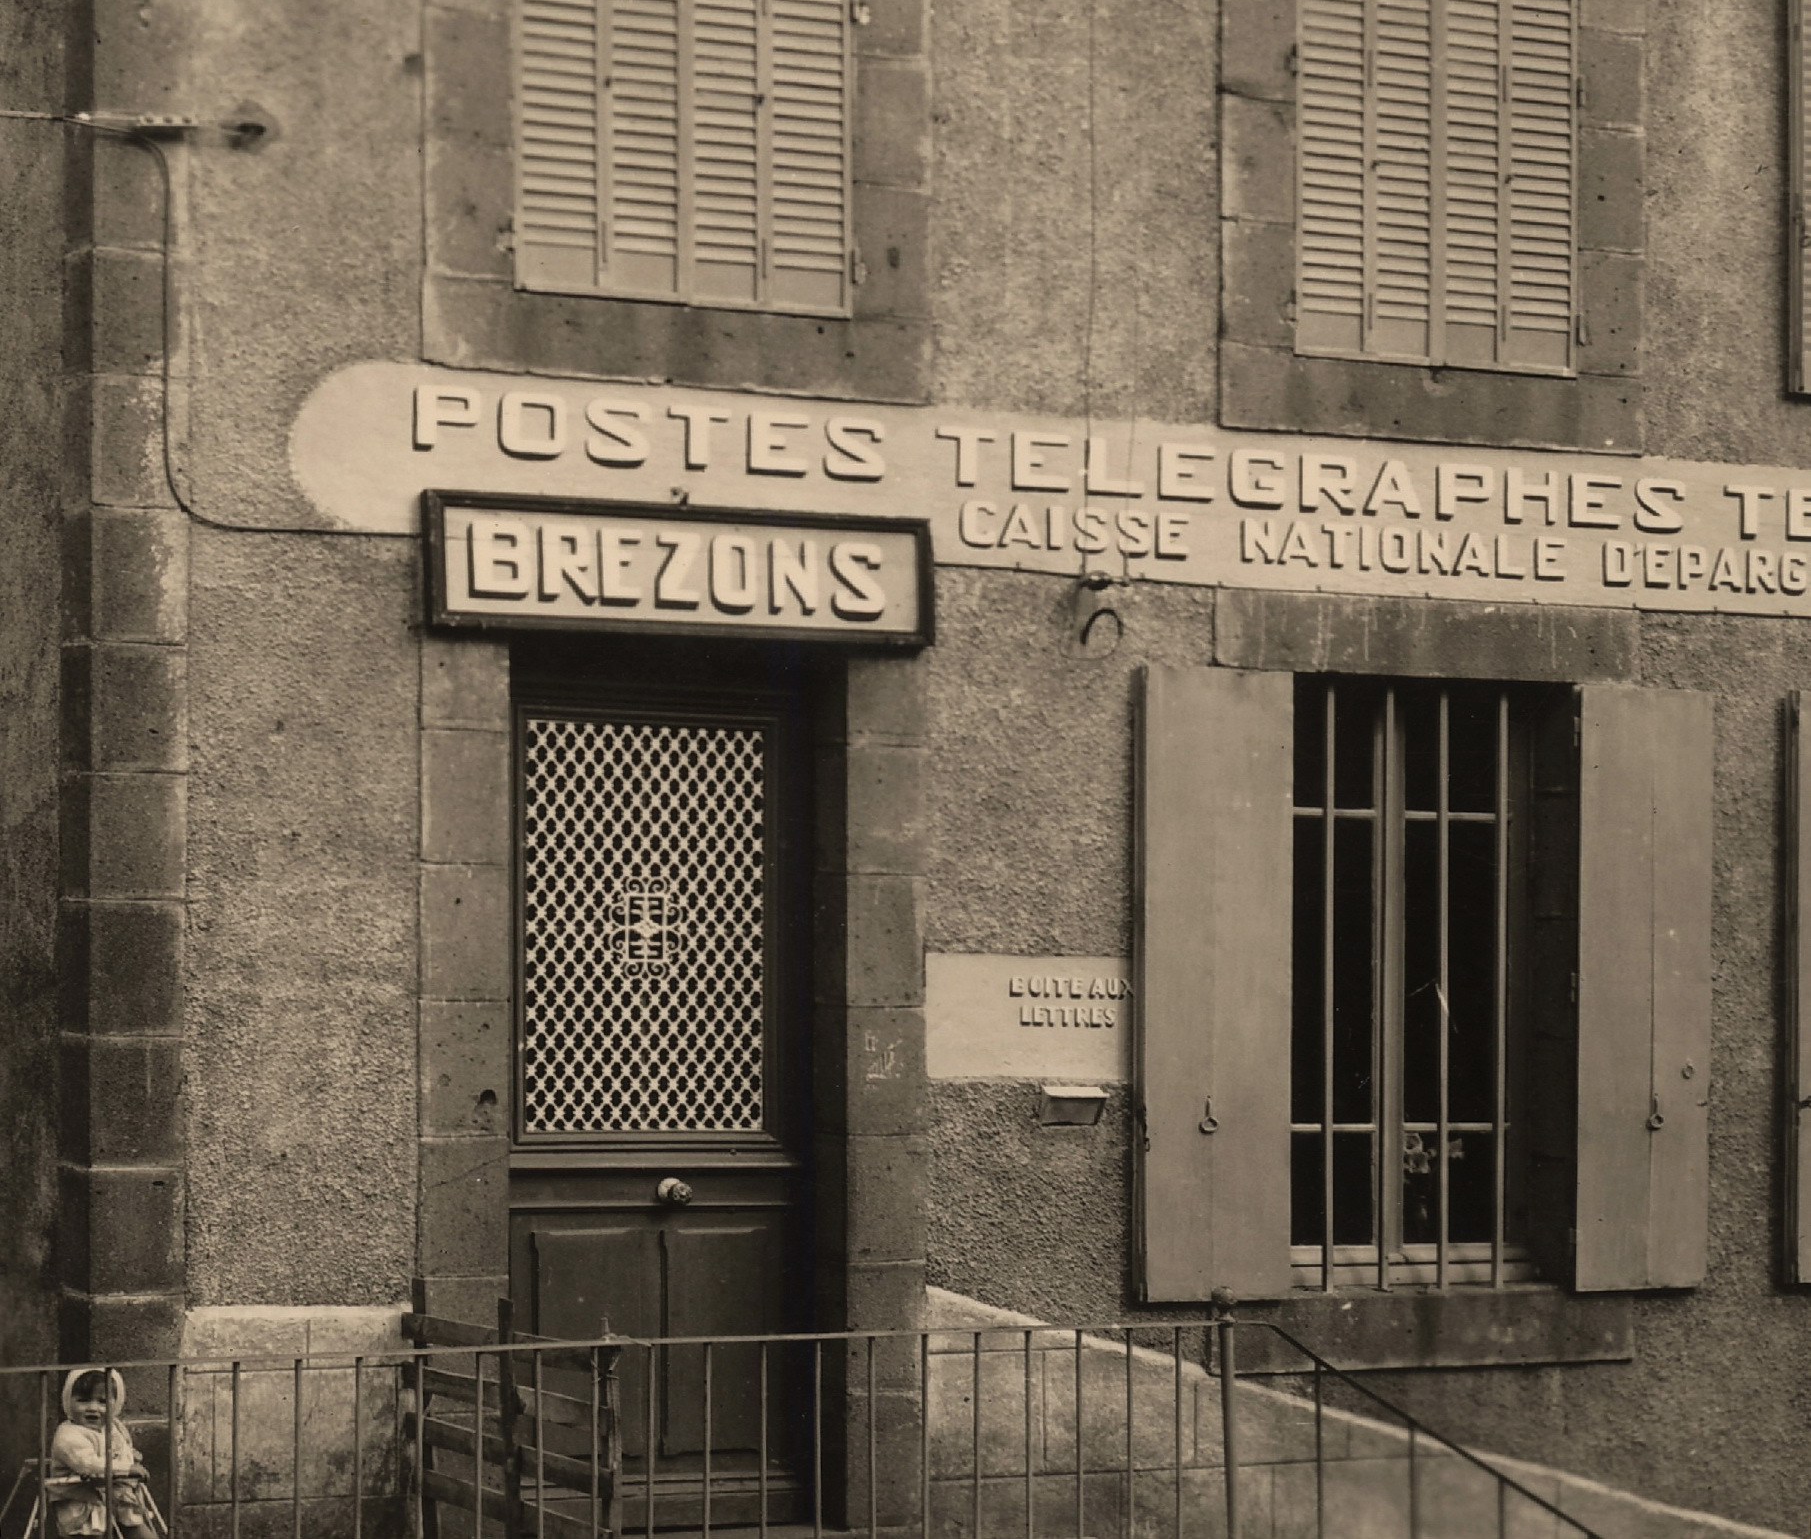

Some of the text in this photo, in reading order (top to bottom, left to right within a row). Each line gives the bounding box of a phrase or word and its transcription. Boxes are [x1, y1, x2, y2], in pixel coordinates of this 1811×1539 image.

[413, 384, 886, 481] POSTES
[935, 425, 1686, 534] TELEGRAPHES
[466, 519, 886, 619] BREZONS
[958, 499, 1808, 597] CAISSE NATIONALE D'EPARG
[1008, 975, 1134, 1000] BOITE AUX
[1019, 1004, 1117, 1029] LETTRES
